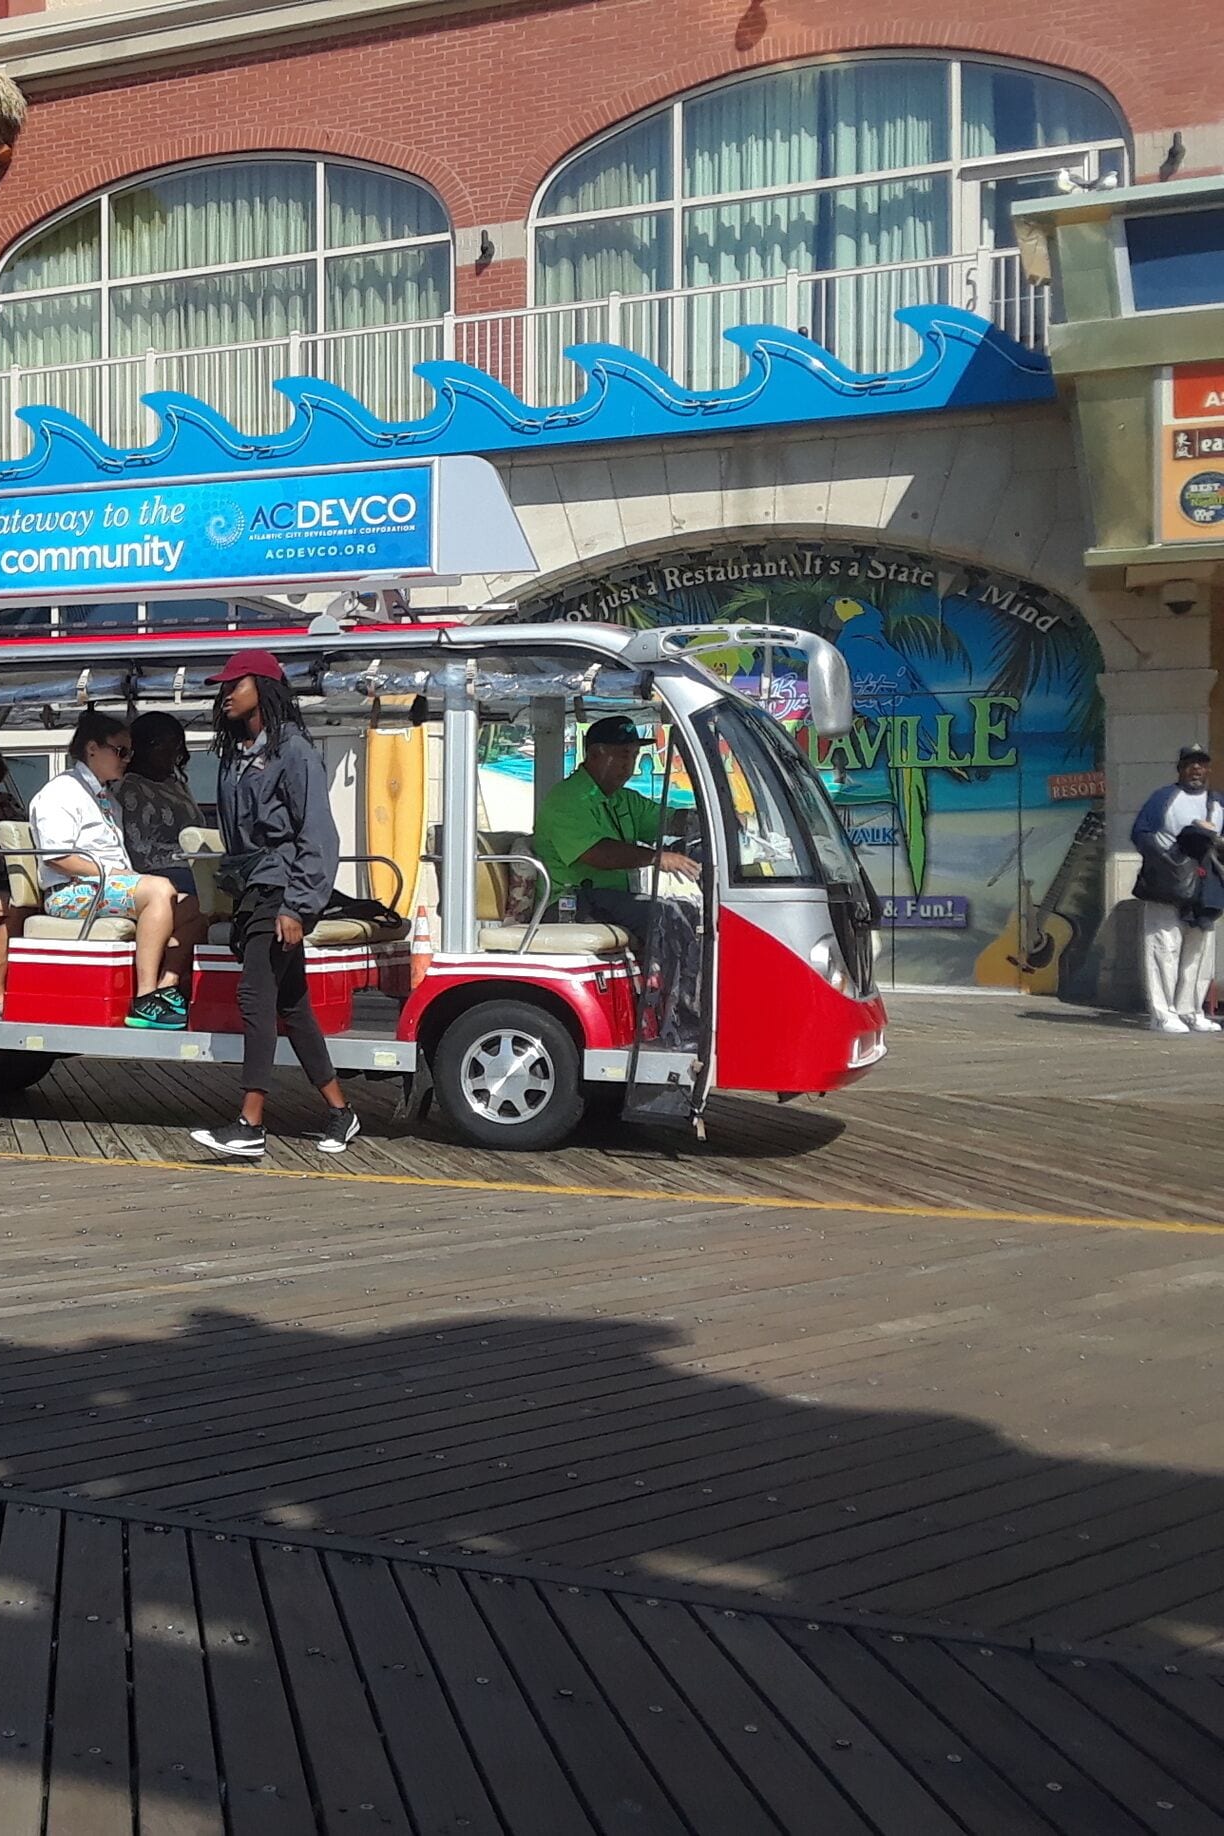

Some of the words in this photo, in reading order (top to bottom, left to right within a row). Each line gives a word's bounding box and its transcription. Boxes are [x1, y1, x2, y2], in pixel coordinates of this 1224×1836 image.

[1201, 437, 1224, 452] ea
[103, 502, 129, 528] to
[139, 495, 186, 526] the
[250, 493, 417, 531] ACDEVCO
[248, 531, 282, 541] ATLANTIC
[304, 527, 357, 538] DEVELOPMENT
[359, 525, 416, 535] CORPORATION
[0, 534, 185, 574] community
[265, 543, 376, 559] ACDEVCO.ORG
[597, 584, 640, 619] just
[647, 580, 658, 596] a
[848, 561, 859, 577] a
[867, 557, 935, 587] State
[978, 584, 1060, 634] Mind
[883, 900, 897, 917] &
